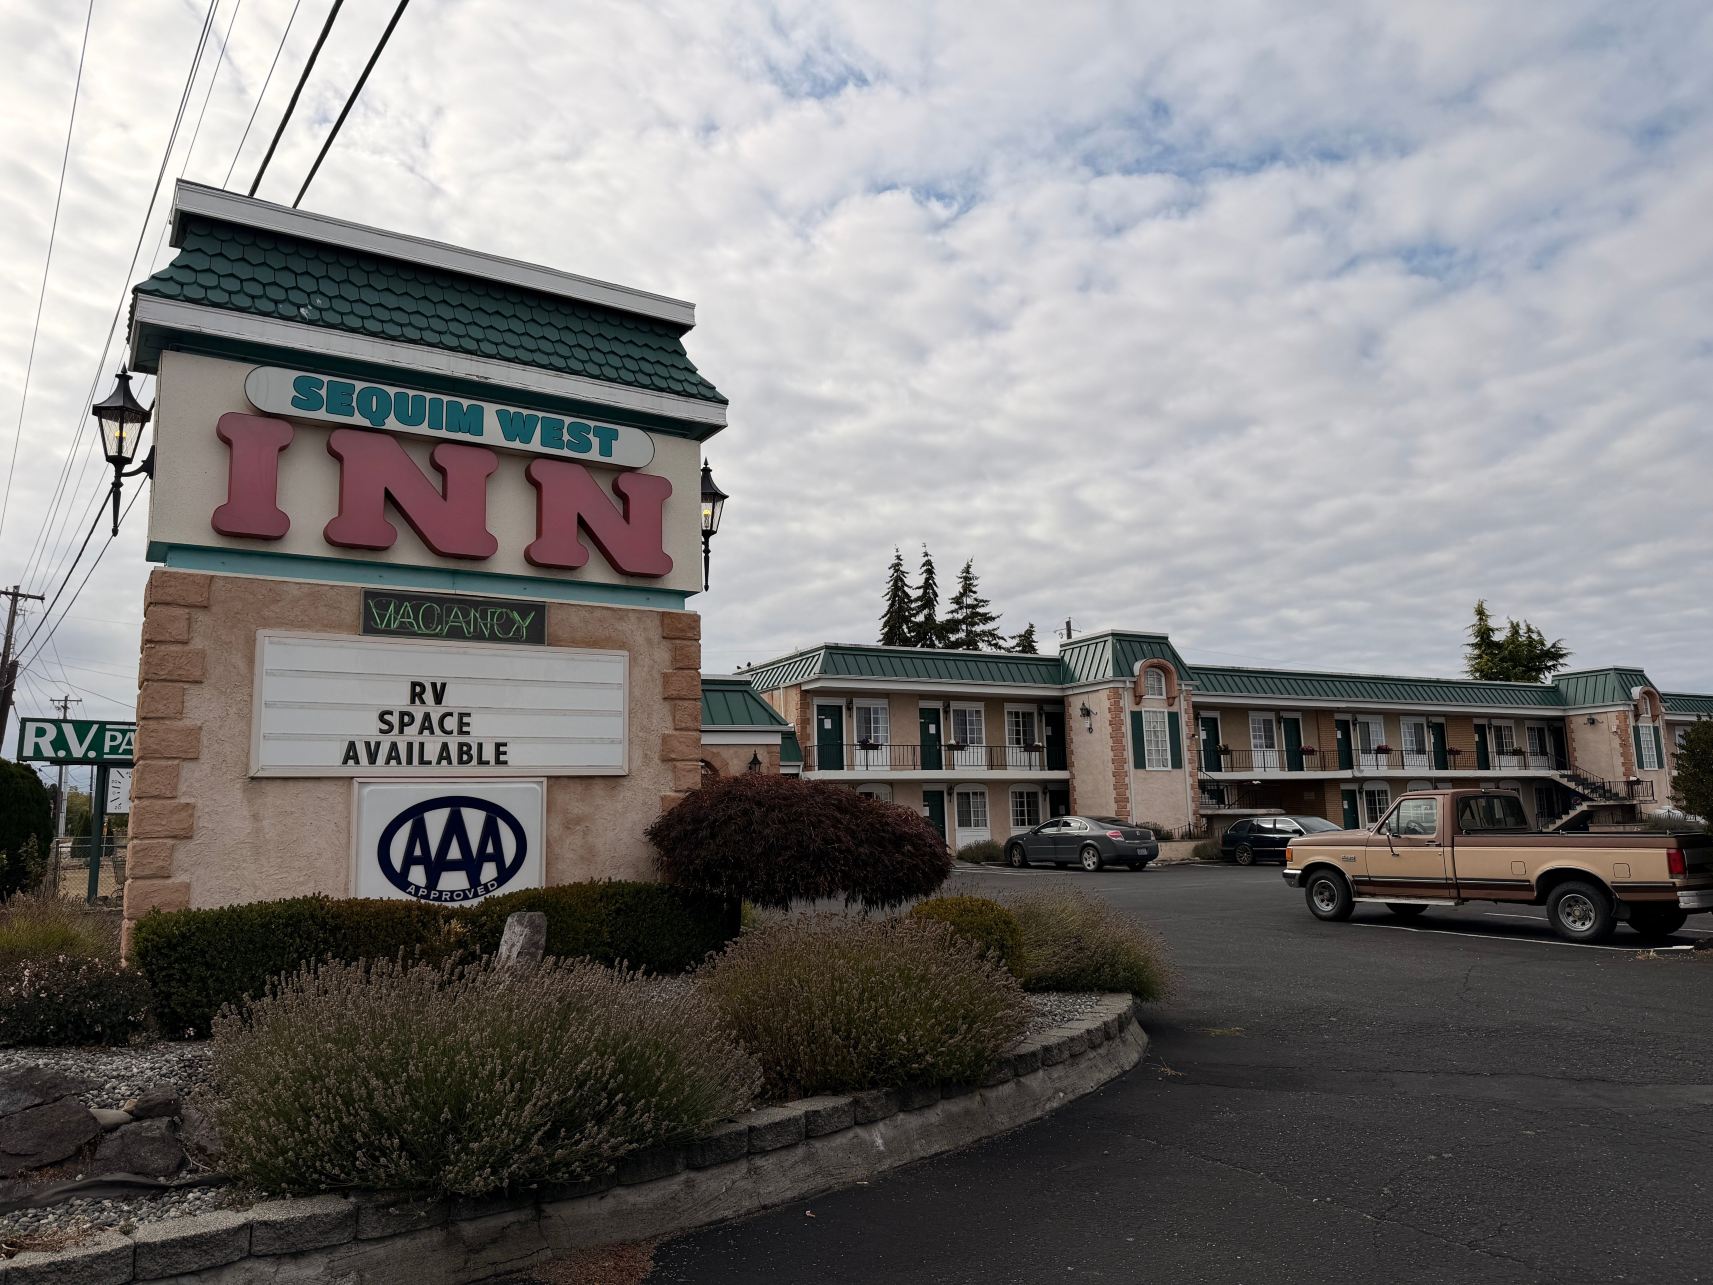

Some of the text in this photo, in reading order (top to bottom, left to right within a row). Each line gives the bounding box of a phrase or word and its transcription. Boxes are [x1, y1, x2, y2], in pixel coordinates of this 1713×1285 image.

[290, 375, 619, 458] SEQUIM WEST
[210, 411, 674, 578] INN
[368, 599, 536, 640] VACANCY
[409, 680, 448, 706] RV
[22, 721, 99, 758] R.V.
[378, 710, 472, 736] SPACE
[341, 740, 509, 766] AVAILABLE
[399, 807, 508, 892] AAA
[406, 880, 499, 901] APPROVED
